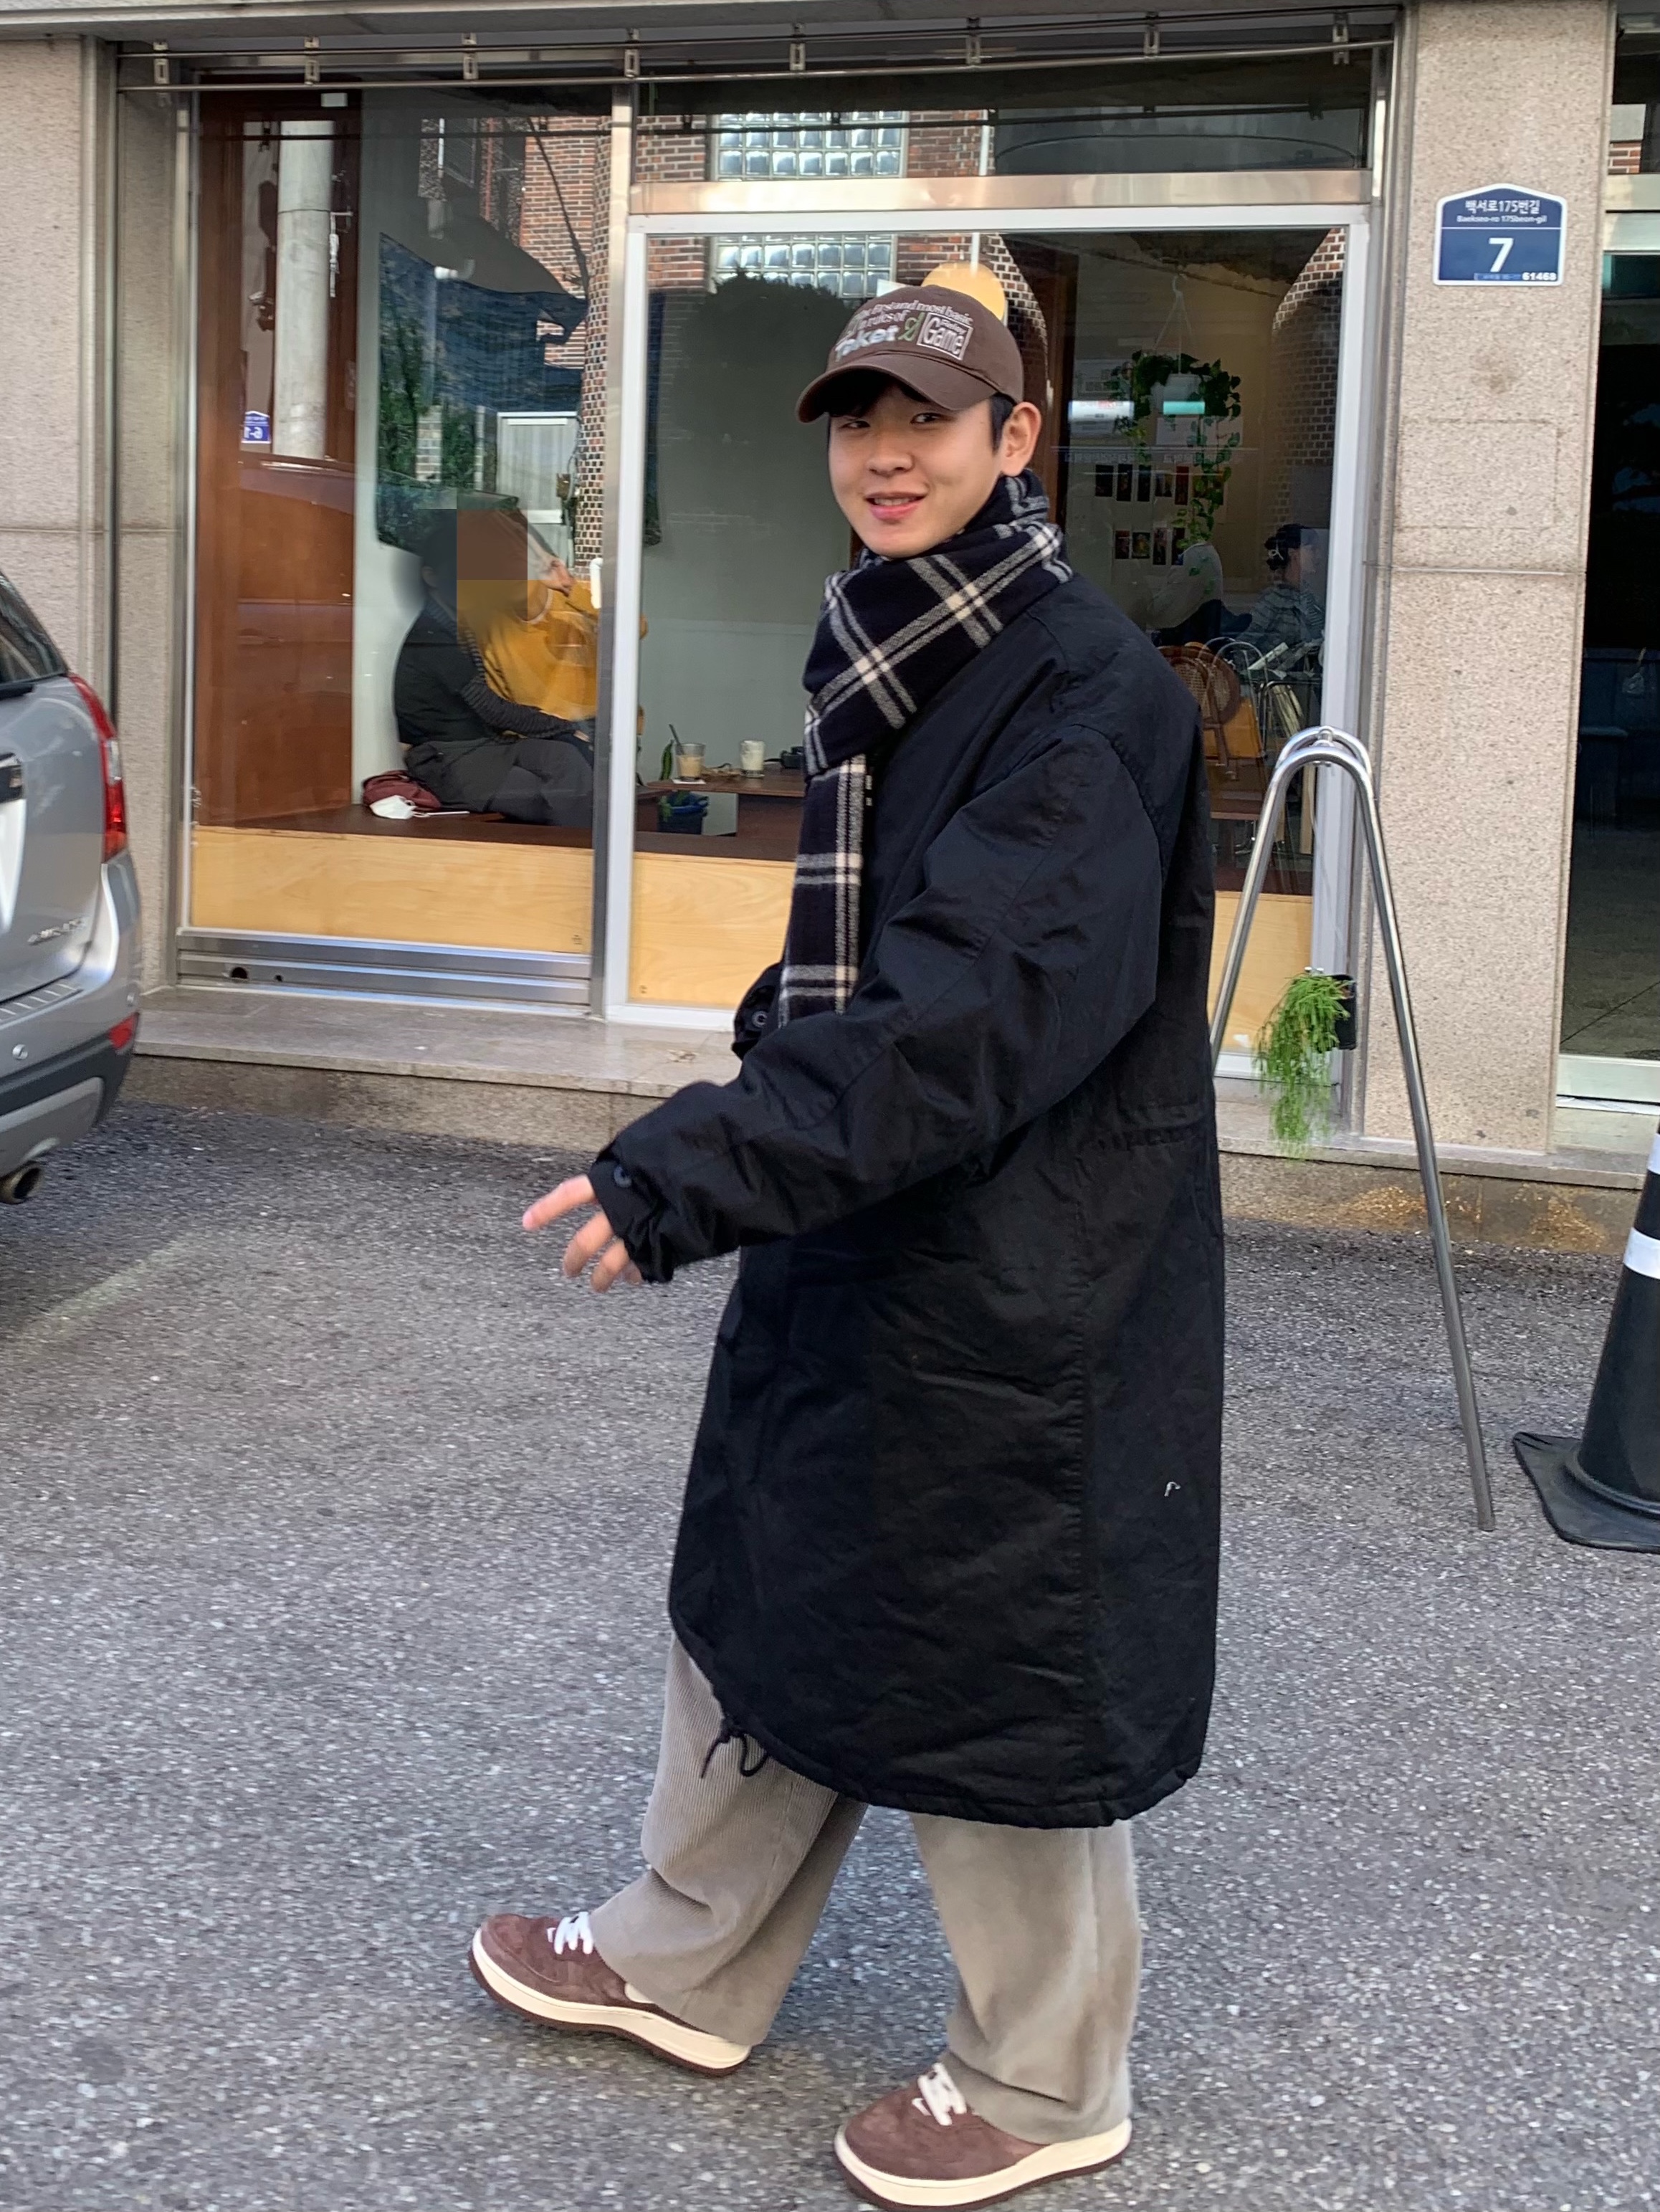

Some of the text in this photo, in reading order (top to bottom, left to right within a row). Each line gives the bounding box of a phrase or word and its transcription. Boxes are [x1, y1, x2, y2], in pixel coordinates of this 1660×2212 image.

[1465, 200, 1540, 214] 백서로175번길
[1489, 237, 1514, 272] 7
[917, 302, 945, 314] most
[893, 310, 911, 322] of
[923, 318, 965, 356] Game
